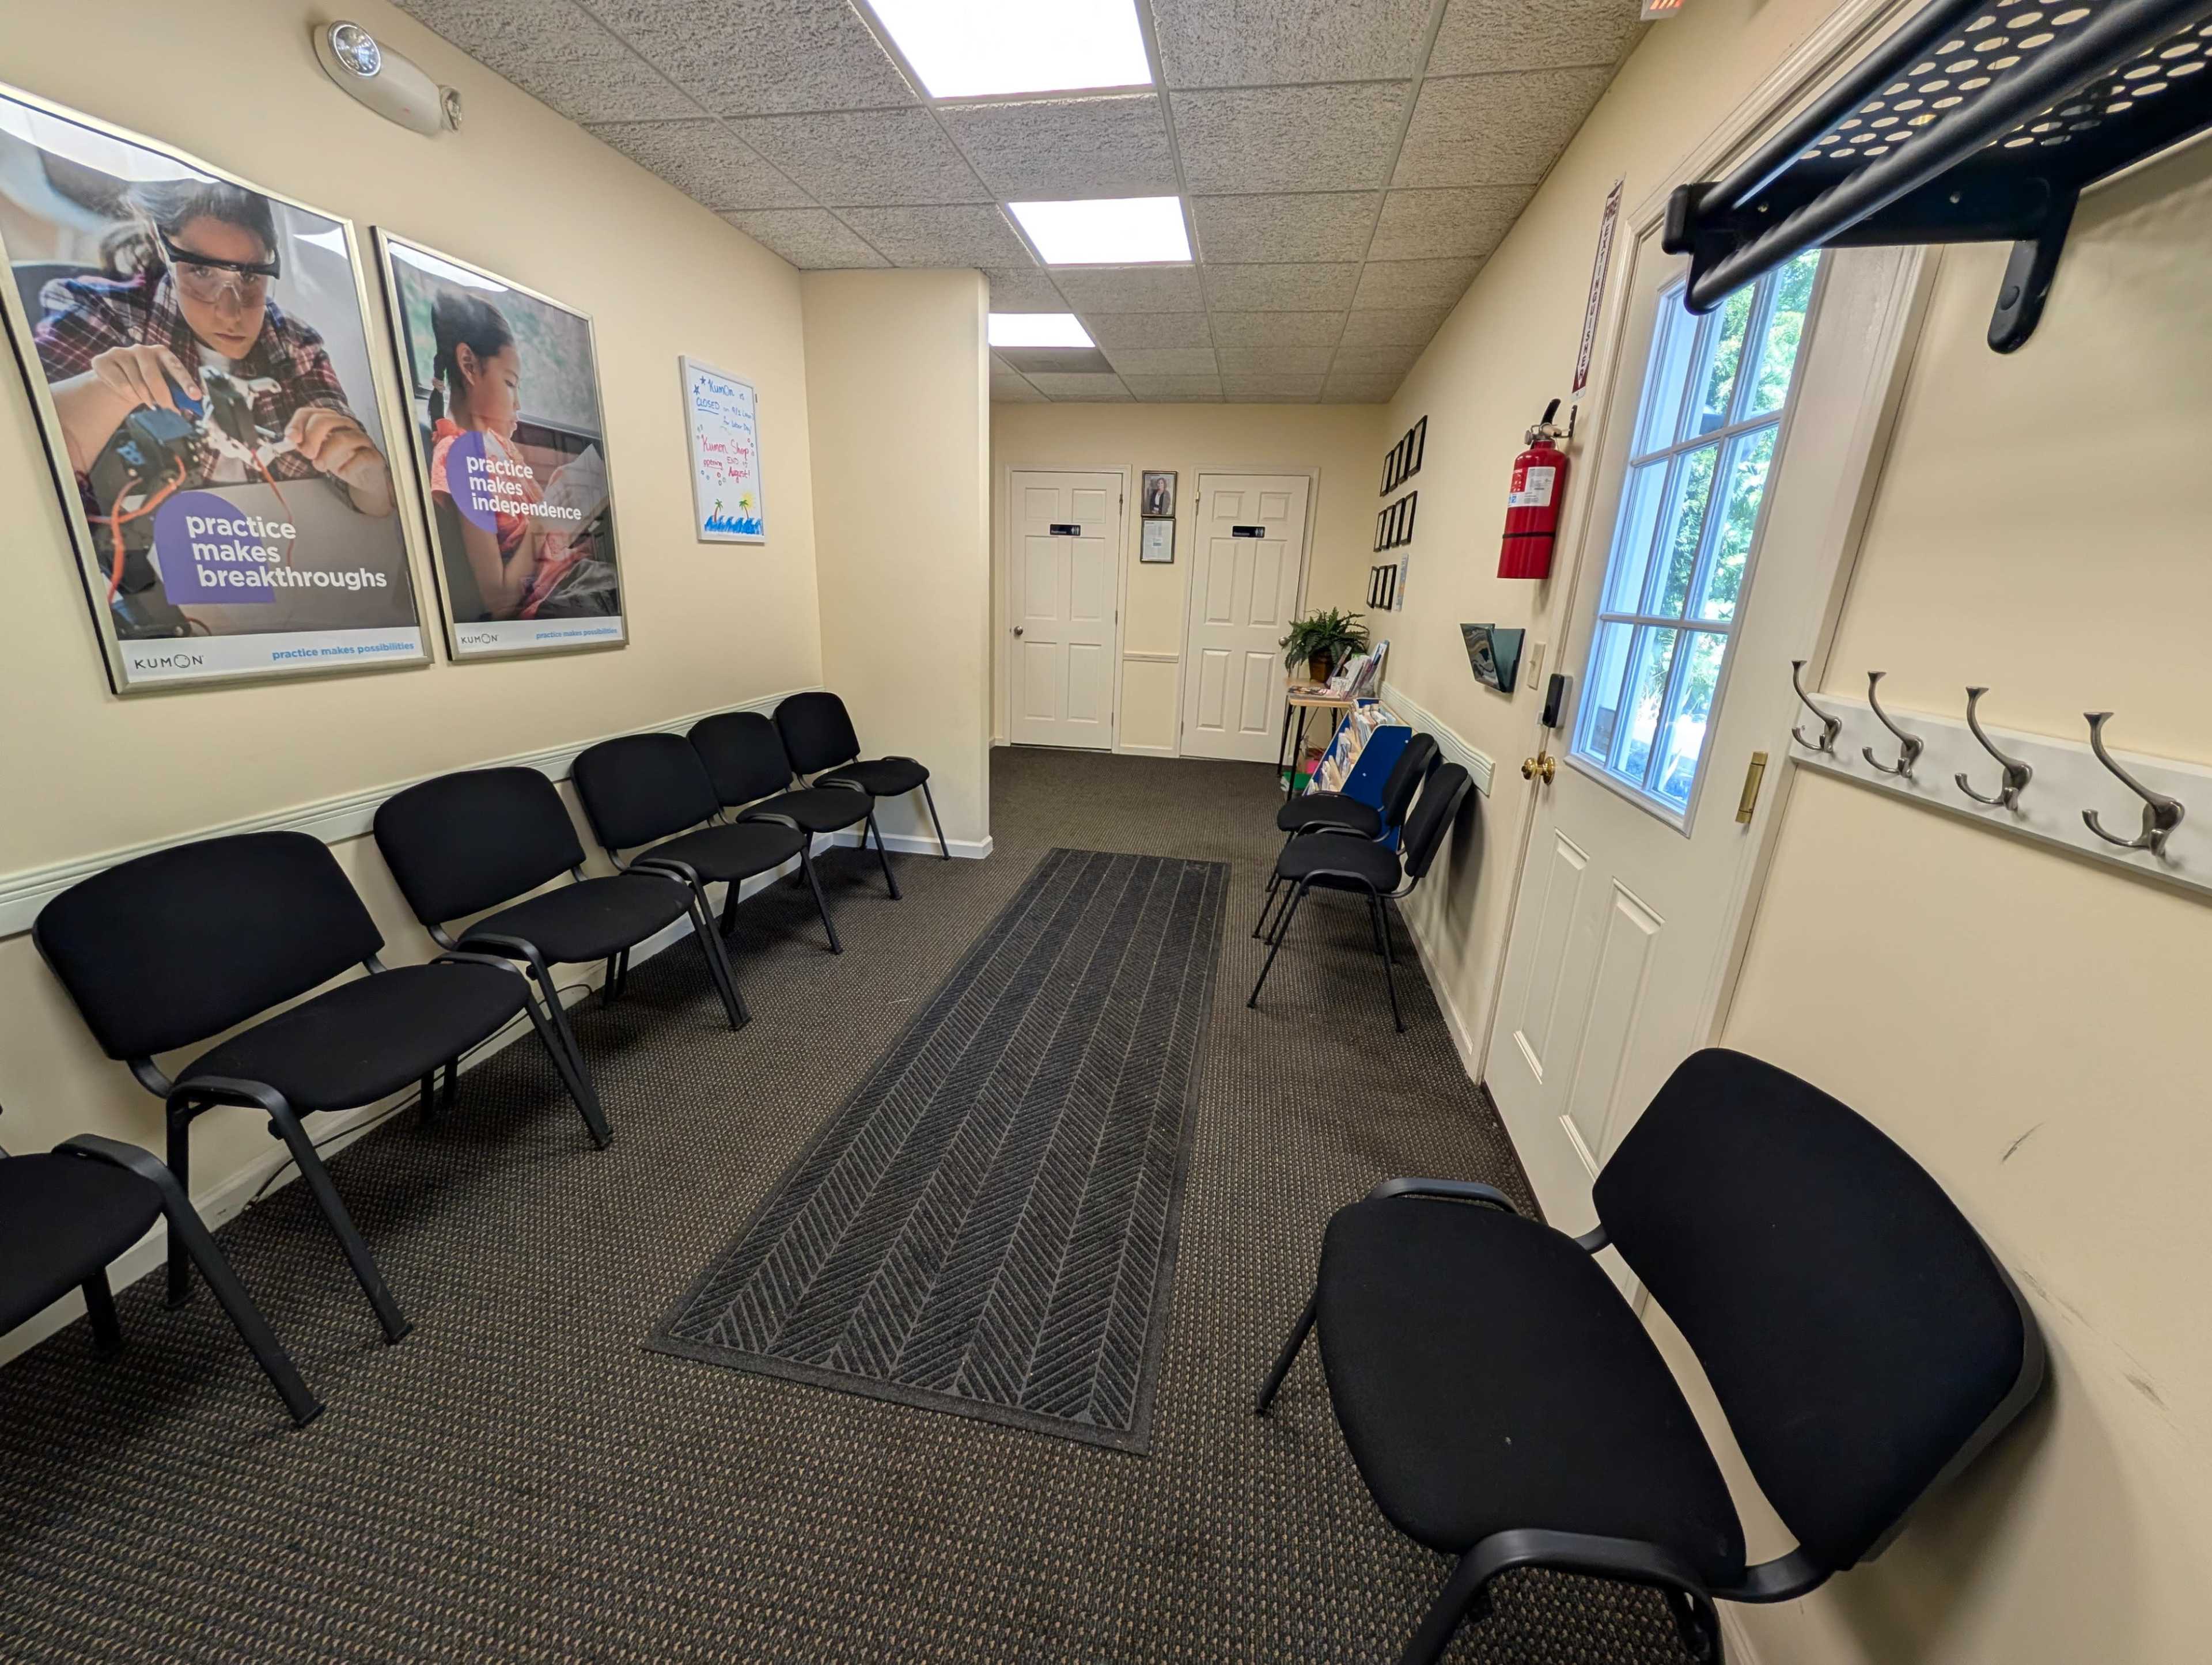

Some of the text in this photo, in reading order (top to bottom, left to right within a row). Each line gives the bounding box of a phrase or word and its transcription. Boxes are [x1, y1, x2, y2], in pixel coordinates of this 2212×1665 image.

[696, 397, 719, 409] CLOSED
[730, 438, 749, 461] Shop
[467, 456, 533, 479] practice
[469, 476, 524, 496] makes
[472, 492, 582, 520] independence
[185, 515, 297, 539] practice
[191, 540, 281, 563] makes
[196, 564, 388, 591] breakthroughs
[461, 633, 498, 644] KUMON
[134, 654, 203, 669] KUMON
[272, 642, 415, 661] practice makes possibilities
